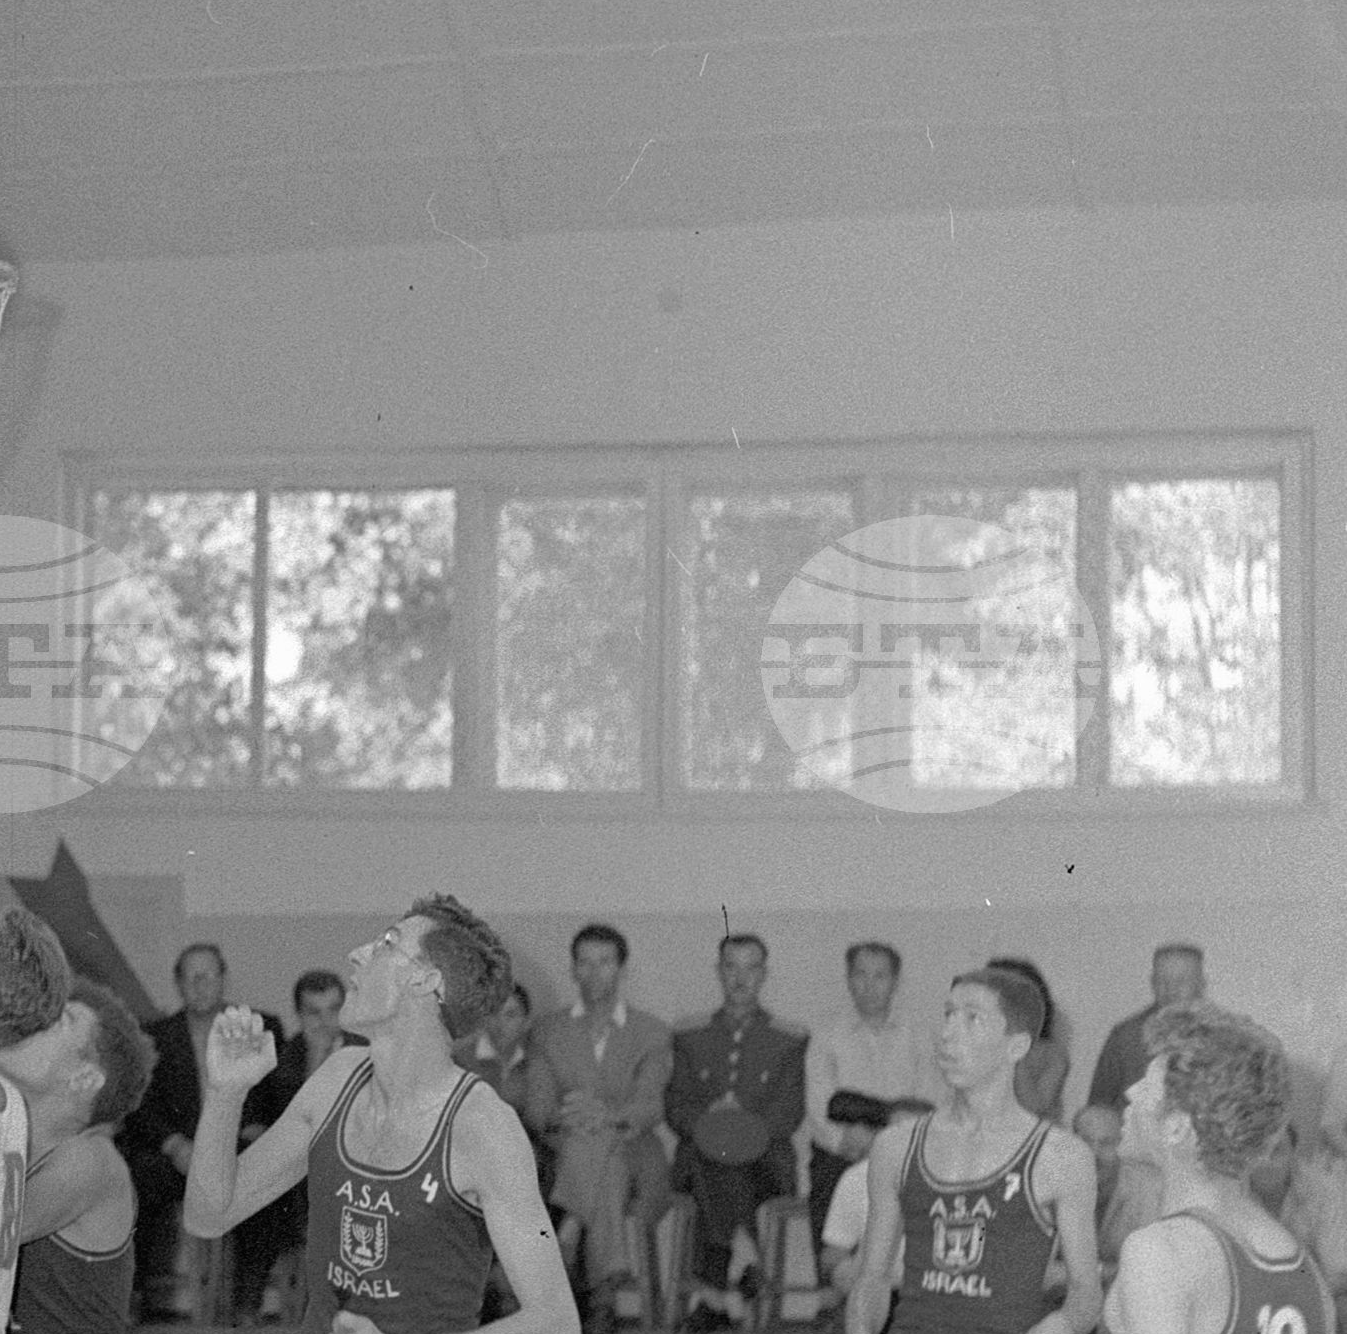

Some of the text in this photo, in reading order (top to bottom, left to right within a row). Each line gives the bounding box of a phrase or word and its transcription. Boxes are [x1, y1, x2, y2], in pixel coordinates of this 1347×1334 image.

[335, 1180, 400, 1217] A.S.A.
[420, 1172, 439, 1204] 4
[1004, 1172, 1021, 1201] 7
[327, 1261, 400, 1299] ISRAEL
[921, 1269, 992, 1298] ISRAEL
